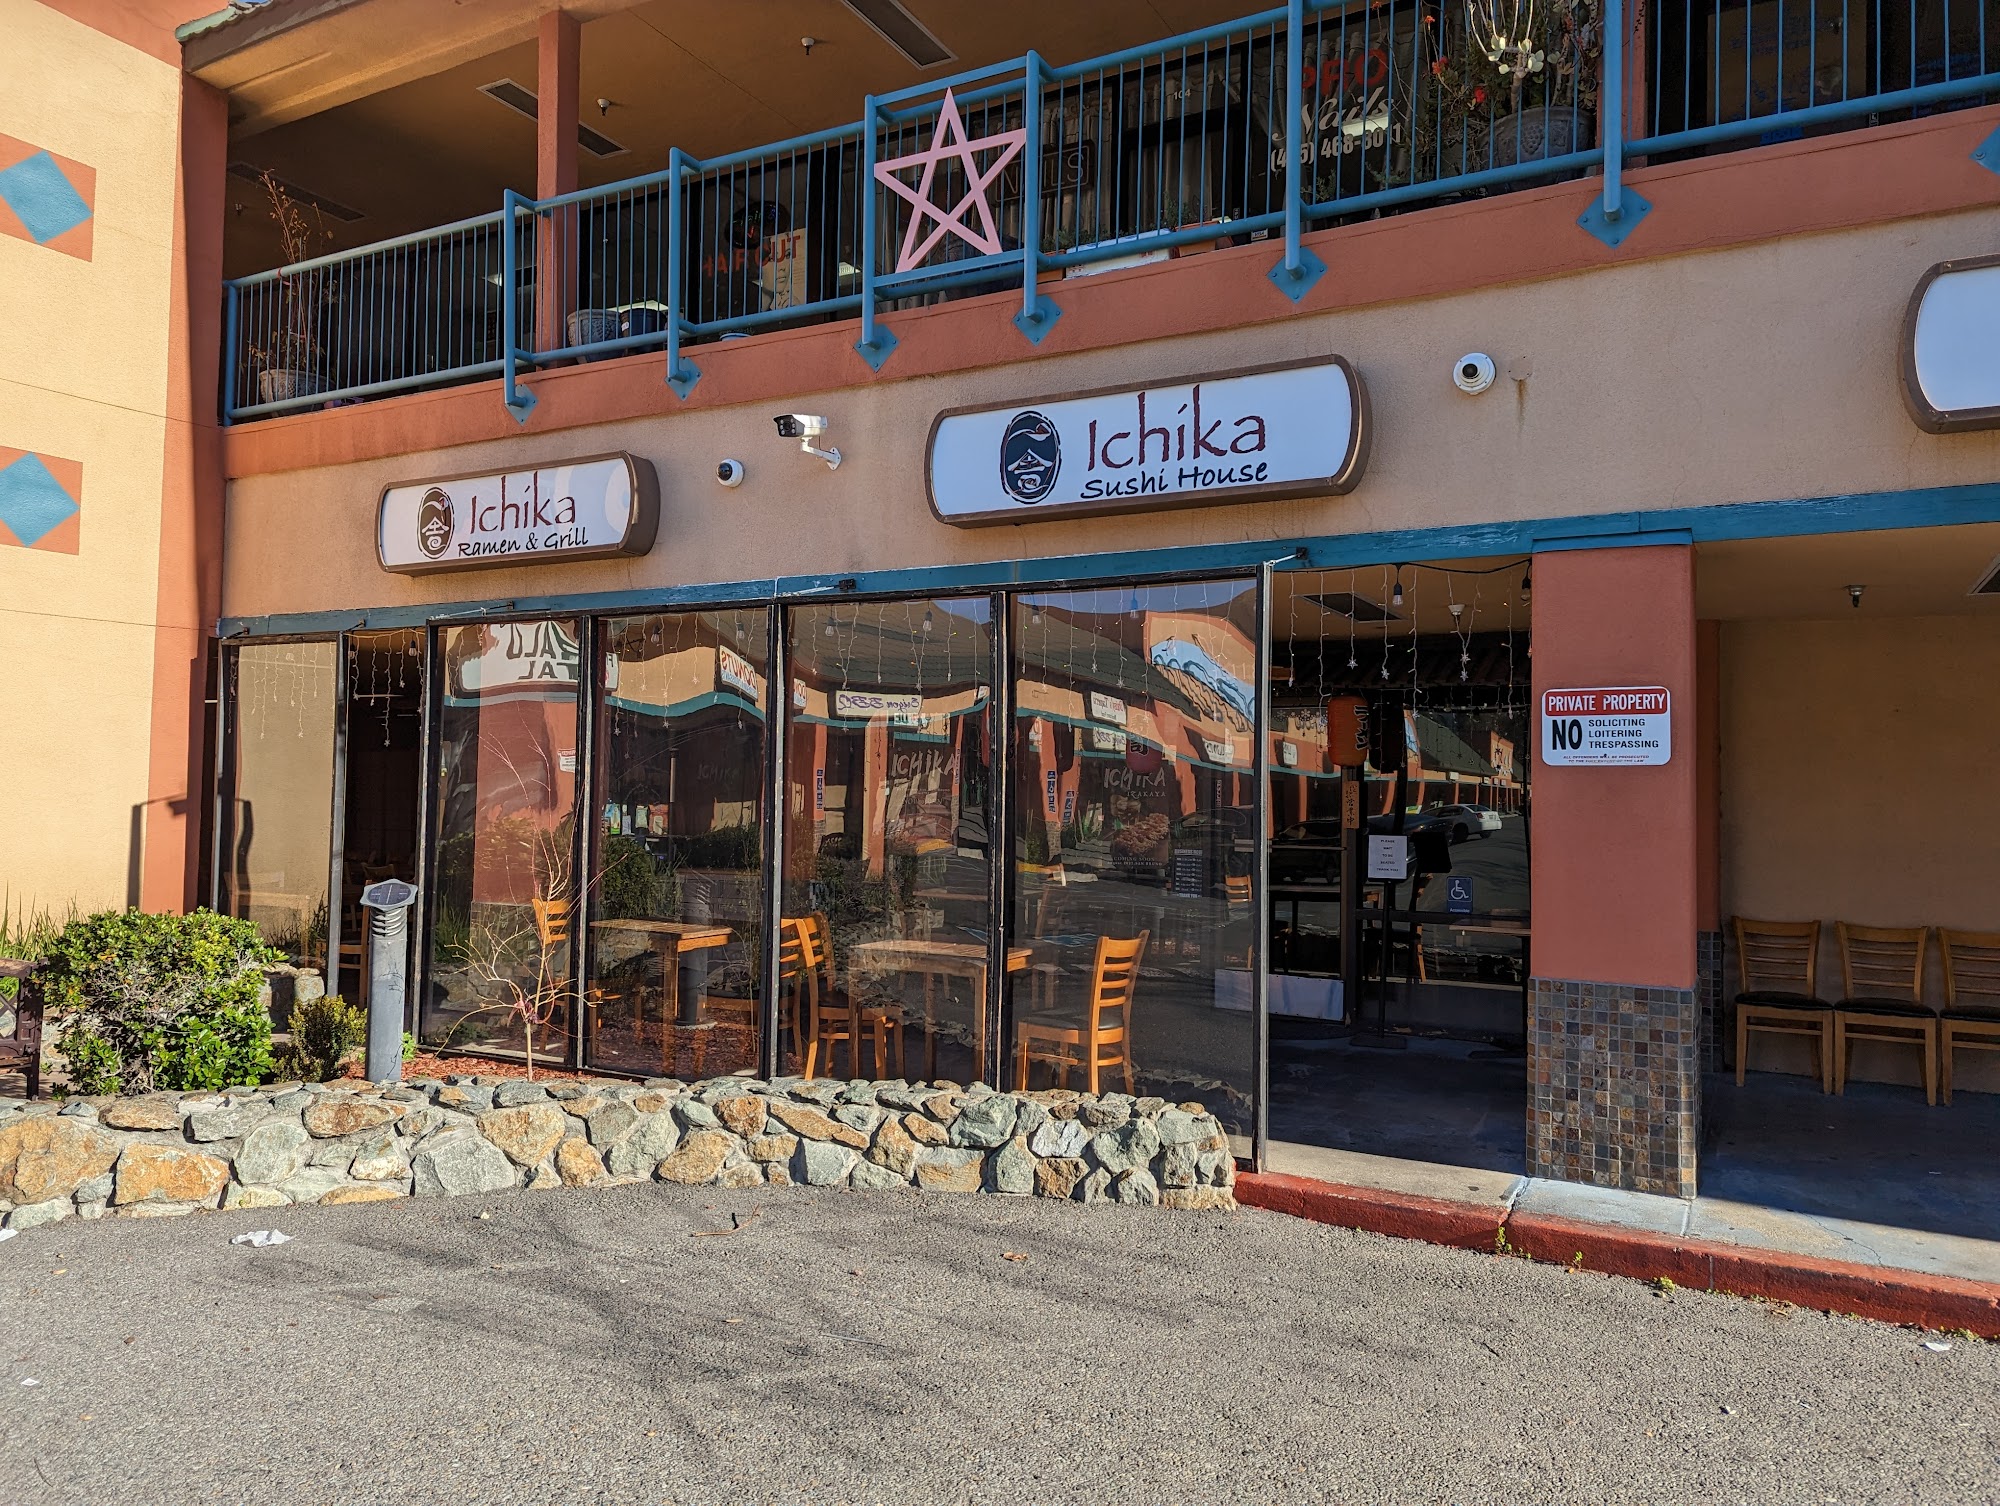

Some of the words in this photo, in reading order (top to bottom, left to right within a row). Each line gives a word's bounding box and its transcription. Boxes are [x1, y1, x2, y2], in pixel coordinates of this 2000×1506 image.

[1301, 49, 1389, 97] PRO
[1173, 89, 1191, 101] 104
[1271, 142, 1315, 172] (45)
[1001, 151, 1085, 196] NILS
[1087, 384, 1266, 472] Ichika
[1080, 468, 1169, 499] Sushi
[1177, 461, 1268, 488] House
[470, 471, 577, 534] Ichika
[458, 538, 521, 557] Ramen
[525, 531, 539, 551] &
[543, 526, 589, 550] Grill
[1549, 695, 1597, 712] PRIVATE
[1603, 693, 1666, 710] PROPERTY
[1552, 718, 1583, 750] NO
[1588, 718, 1646, 728] SOLICITING
[1588, 729, 1642, 738] LOITERING
[1589, 740, 1659, 749] TRESPASSING
[1127, 790, 1166, 799] IZAKAYA
